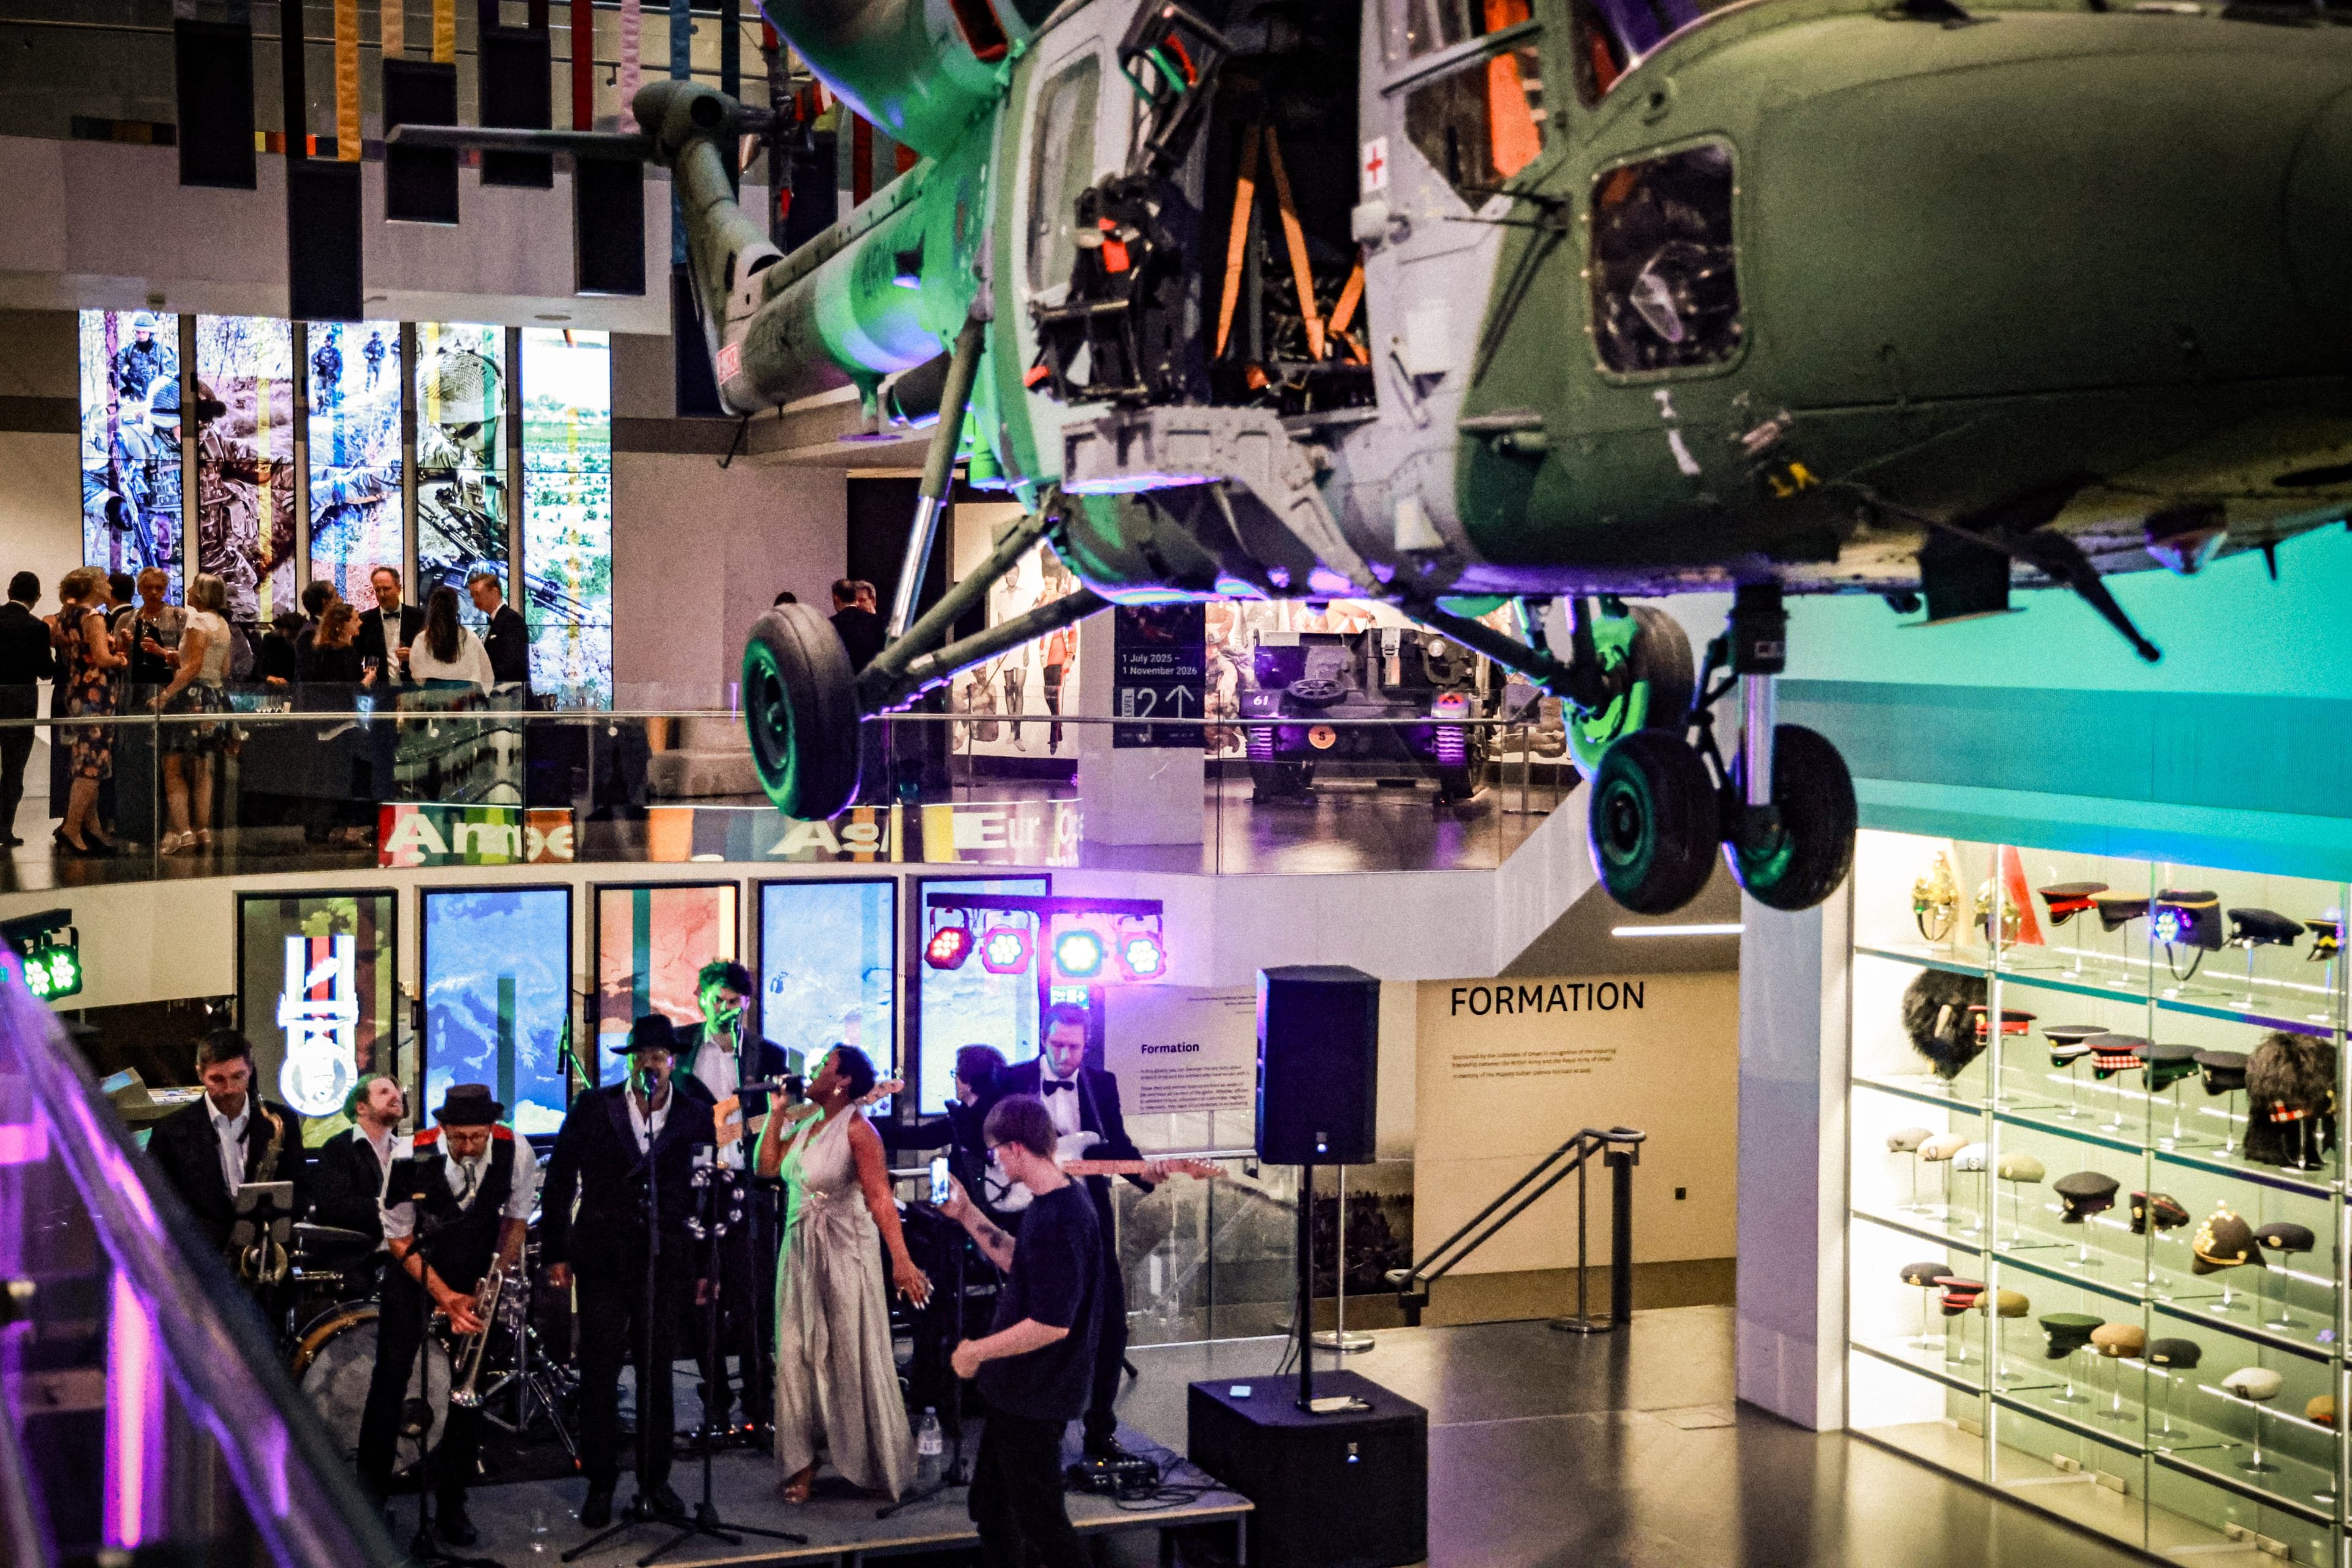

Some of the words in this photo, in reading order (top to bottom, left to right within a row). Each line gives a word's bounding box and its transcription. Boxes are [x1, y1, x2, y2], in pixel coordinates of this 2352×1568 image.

[1122, 654, 1127, 663] 1
[1130, 654, 1148, 665] July
[1150, 654, 1172, 663] 2025
[1129, 666, 1175, 675] November
[1176, 666, 1198, 676] 2026
[1137, 688, 1158, 718] 2
[1253, 695, 1269, 706] 61
[1452, 981, 1644, 1016] FORMATION
[1141, 1041, 1200, 1054] Formation
